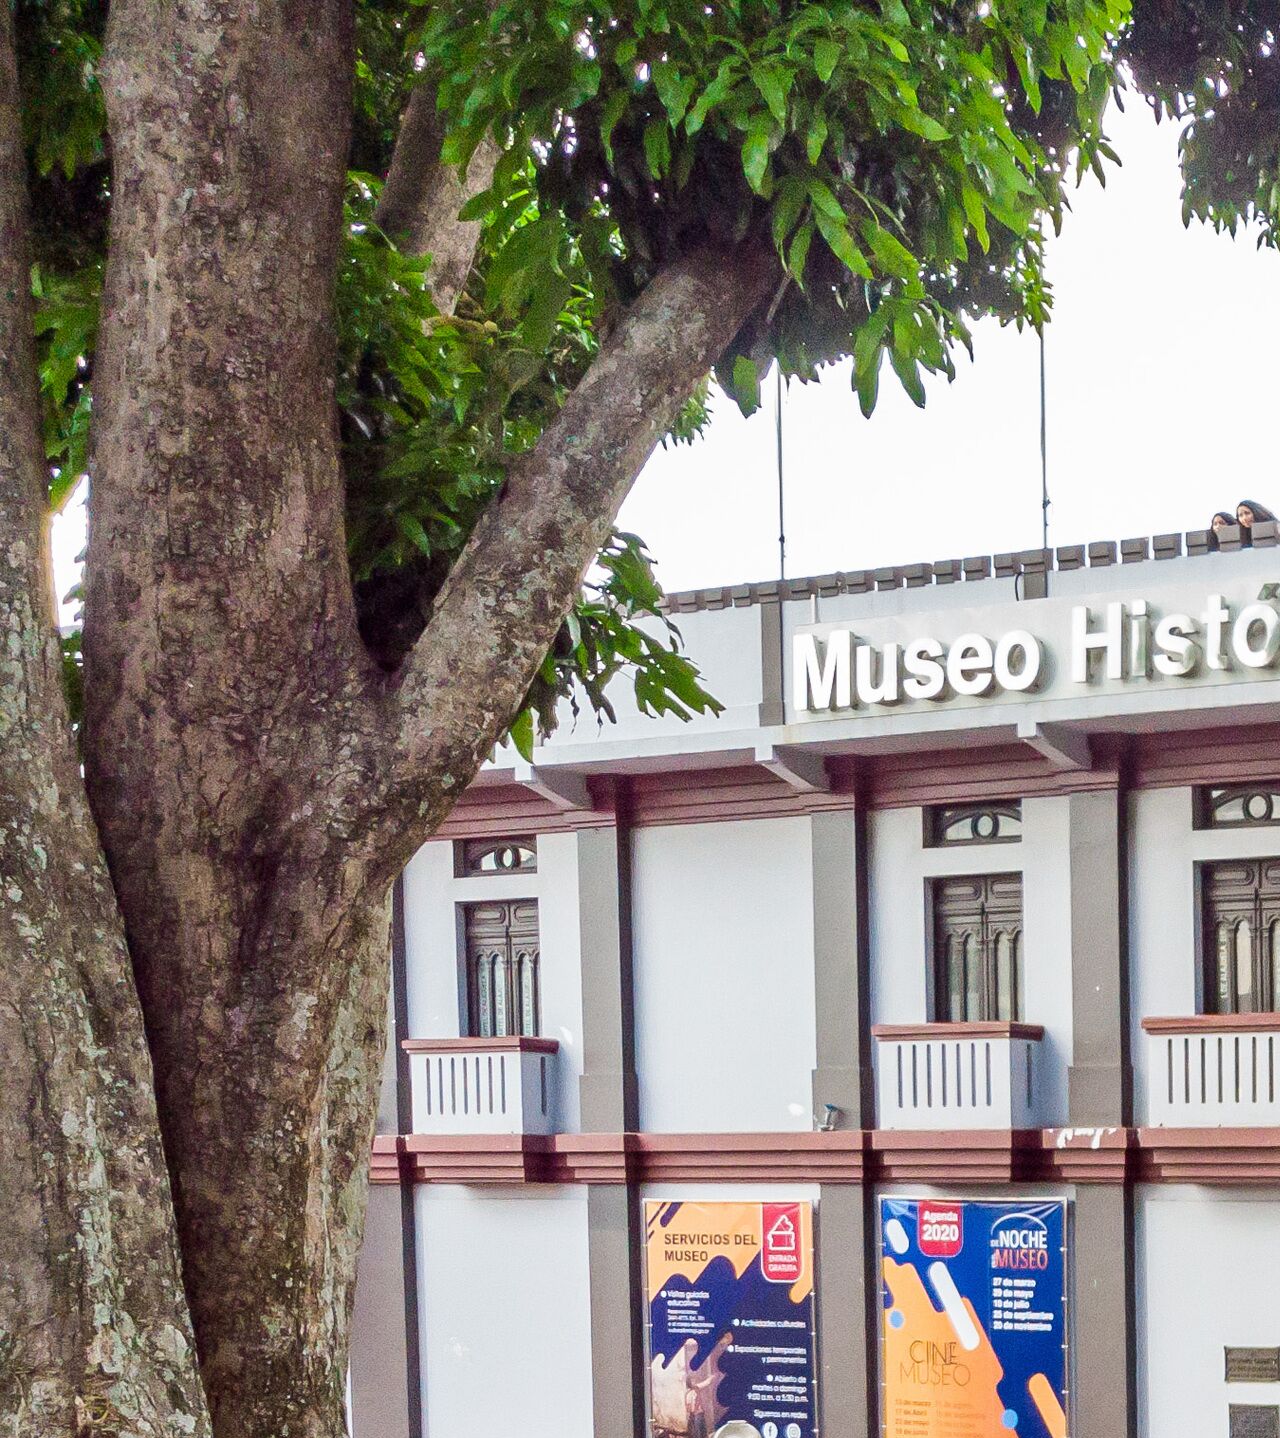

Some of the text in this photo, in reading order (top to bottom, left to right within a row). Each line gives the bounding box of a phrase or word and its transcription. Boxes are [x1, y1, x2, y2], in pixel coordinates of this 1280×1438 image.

[793, 629, 1041, 712] Museo
[923, 1211, 958, 1223] Agenda
[923, 1224, 959, 1241] 2020
[664, 1234, 758, 1246] SERVICIOS DEL
[999, 1230, 1048, 1248] NOCHE
[664, 1251, 709, 1262] MUSEO
[995, 1249, 1048, 1270] MUSEO
[1003, 1278, 1013, 1287] de
[1013, 1279, 1036, 1287] marzo
[1003, 1289, 1013, 1298] de
[1003, 1299, 1013, 1308] de
[1003, 1310, 1013, 1319] de
[1003, 1321, 1013, 1330] de
[909, 1340, 957, 1366] CINE
[900, 1362, 971, 1386] MUSEO
